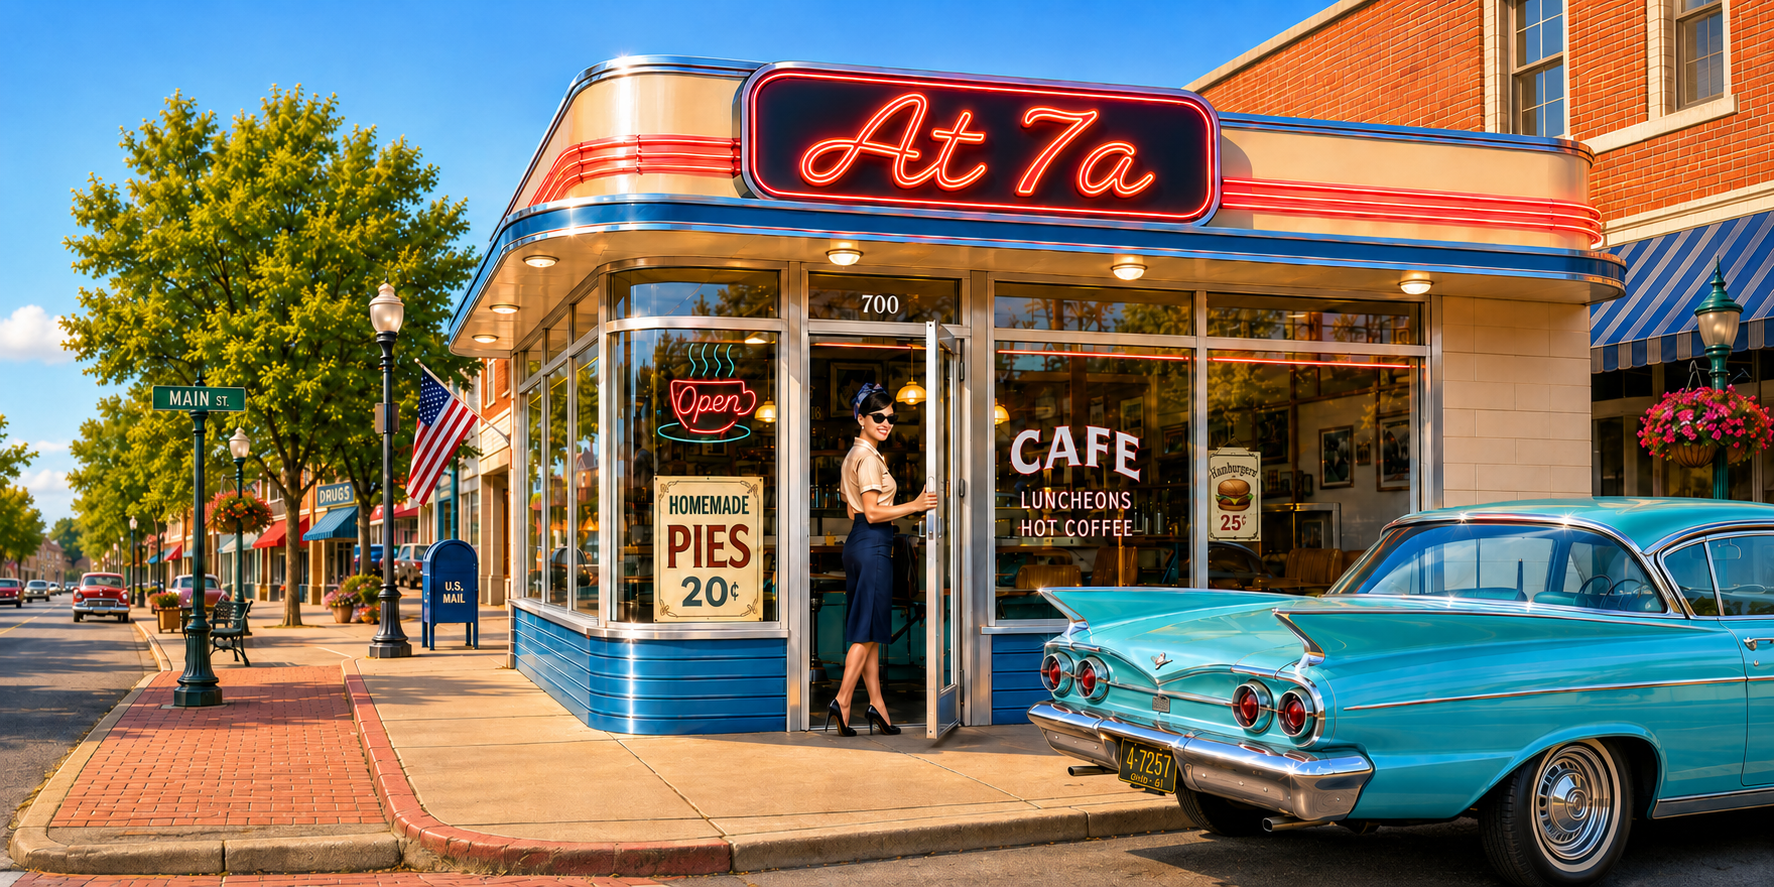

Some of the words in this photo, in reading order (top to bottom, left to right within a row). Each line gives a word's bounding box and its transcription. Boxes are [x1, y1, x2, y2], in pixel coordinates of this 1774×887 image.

[799, 92, 987, 189] At
[1015, 107, 1156, 197] 7a
[862, 294, 899, 314] 700
[169, 390, 209, 406] MAIN
[216, 395, 229, 406] ST.
[678, 386, 741, 423] Open
[1010, 425, 1141, 482] CAFE
[1210, 462, 1258, 479] Hamburgers
[320, 485, 350, 503] DRUGS
[1021, 491, 1131, 509] LUNCHEONS
[669, 495, 750, 515] HOMEMADE
[1021, 519, 1058, 537] HOT
[1065, 519, 1133, 537] COFFEE
[1220, 514, 1247, 531] 25¢
[667, 523, 751, 569] PIES
[445, 581, 464, 591] U.S.
[681, 576, 739, 607] 20¢
[443, 593, 466, 604] MAIL
